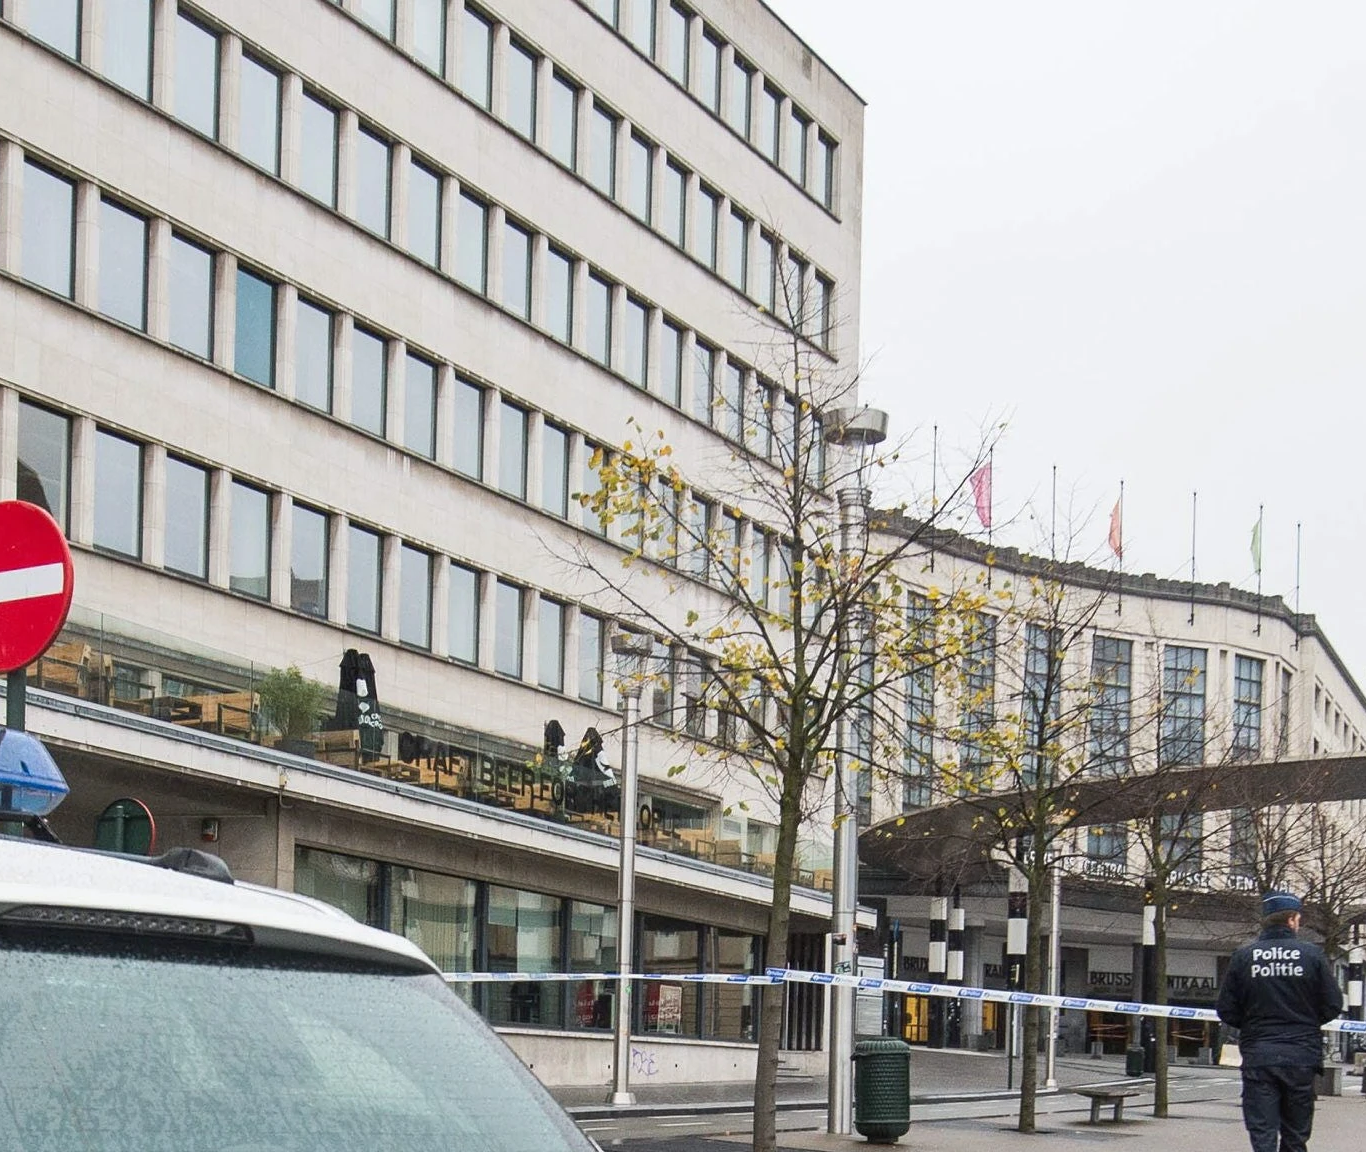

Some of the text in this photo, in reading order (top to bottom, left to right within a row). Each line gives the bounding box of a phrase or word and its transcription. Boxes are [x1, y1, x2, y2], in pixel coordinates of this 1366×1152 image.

[1252, 946, 1301, 961] Police
[1251, 962, 1304, 978] Politie
[1089, 972, 1132, 987] BRUSS
